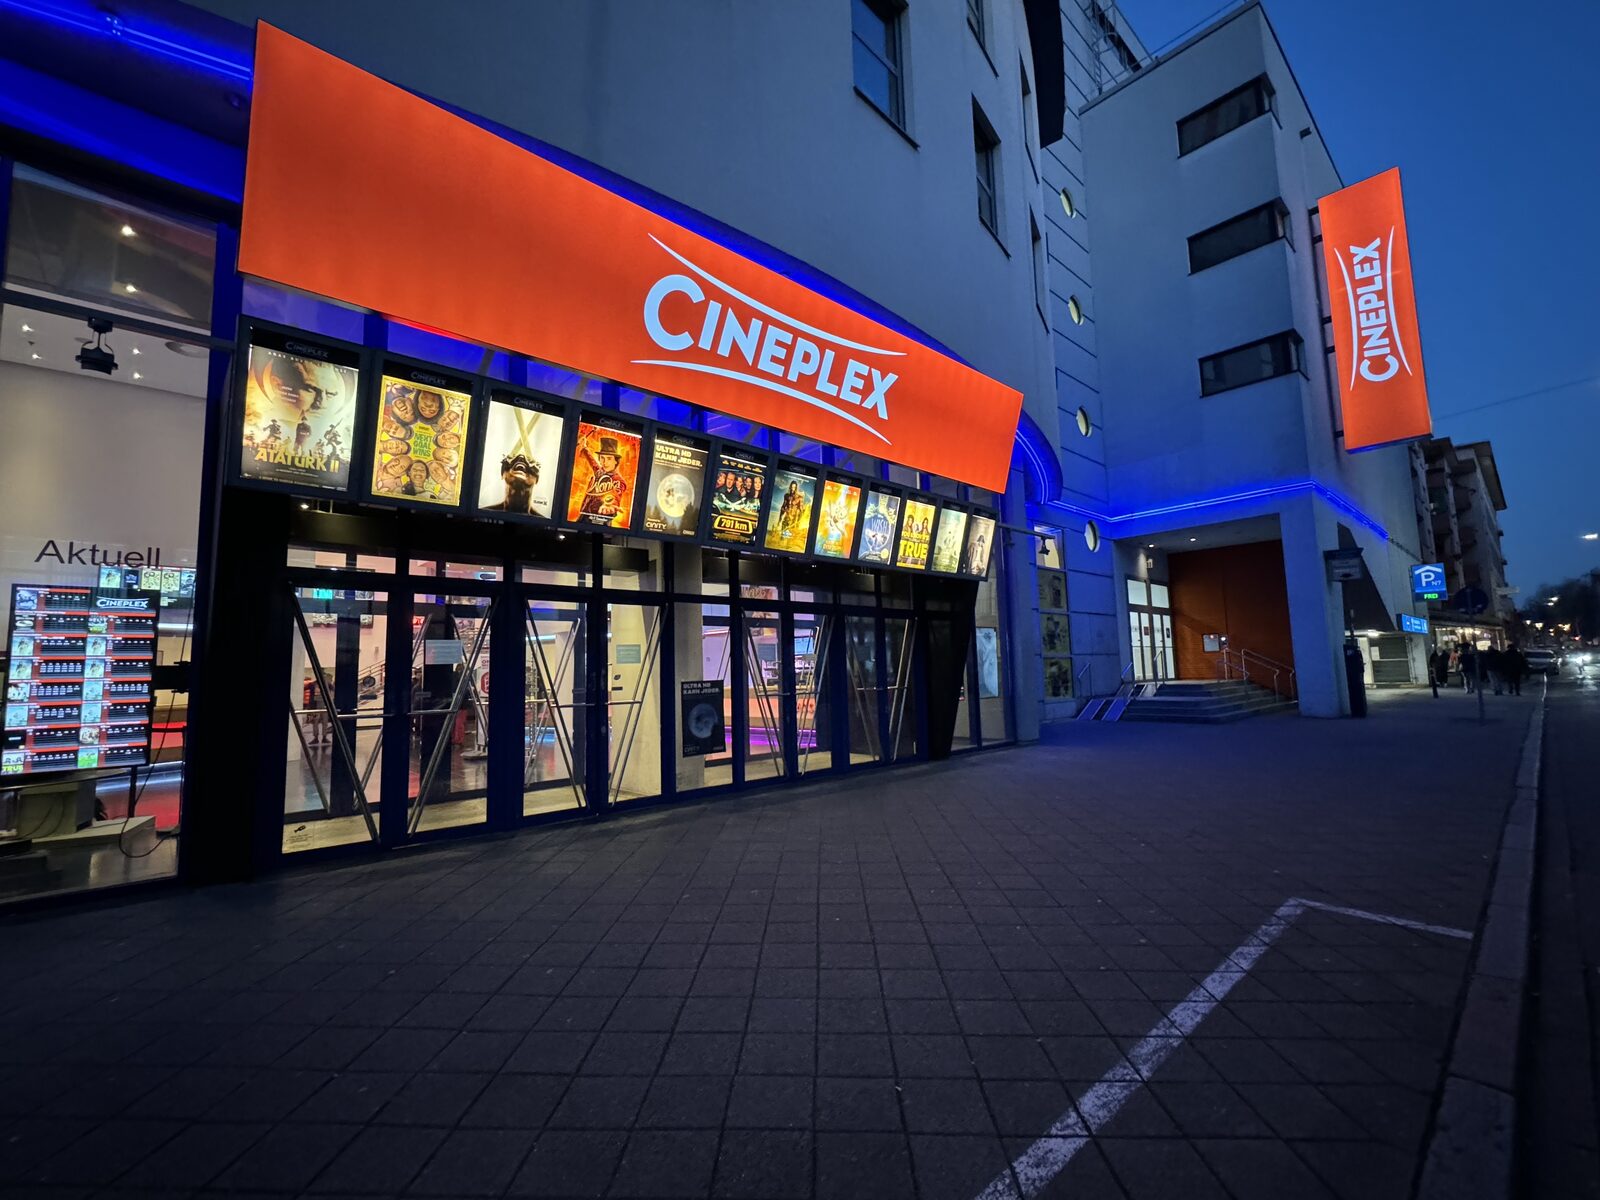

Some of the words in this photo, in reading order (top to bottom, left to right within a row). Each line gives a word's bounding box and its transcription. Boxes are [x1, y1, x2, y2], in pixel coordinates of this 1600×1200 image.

[1349, 237, 1399, 382] CINEPLEX
[285, 342, 329, 358] CINEPLEX
[643, 274, 899, 420] CINEPLEX
[413, 440, 431, 449] GOAL
[414, 432, 432, 441] NEXT
[413, 447, 431, 457] WINS
[654, 451, 677, 462] KANN
[677, 456, 703, 467] JEDER.
[655, 444, 680, 456] ULTRA
[681, 450, 692, 458] HD
[330, 460, 340, 473] II
[586, 475, 621, 495] Wonka
[721, 518, 734, 529] 791
[735, 520, 748, 531] km
[871, 518, 888, 534] WISH
[34, 540, 160, 569] Aktuell
[900, 540, 929, 559] TRUE
[1421, 571, 1435, 587] P
[96, 598, 149, 609] CINEPLEX
